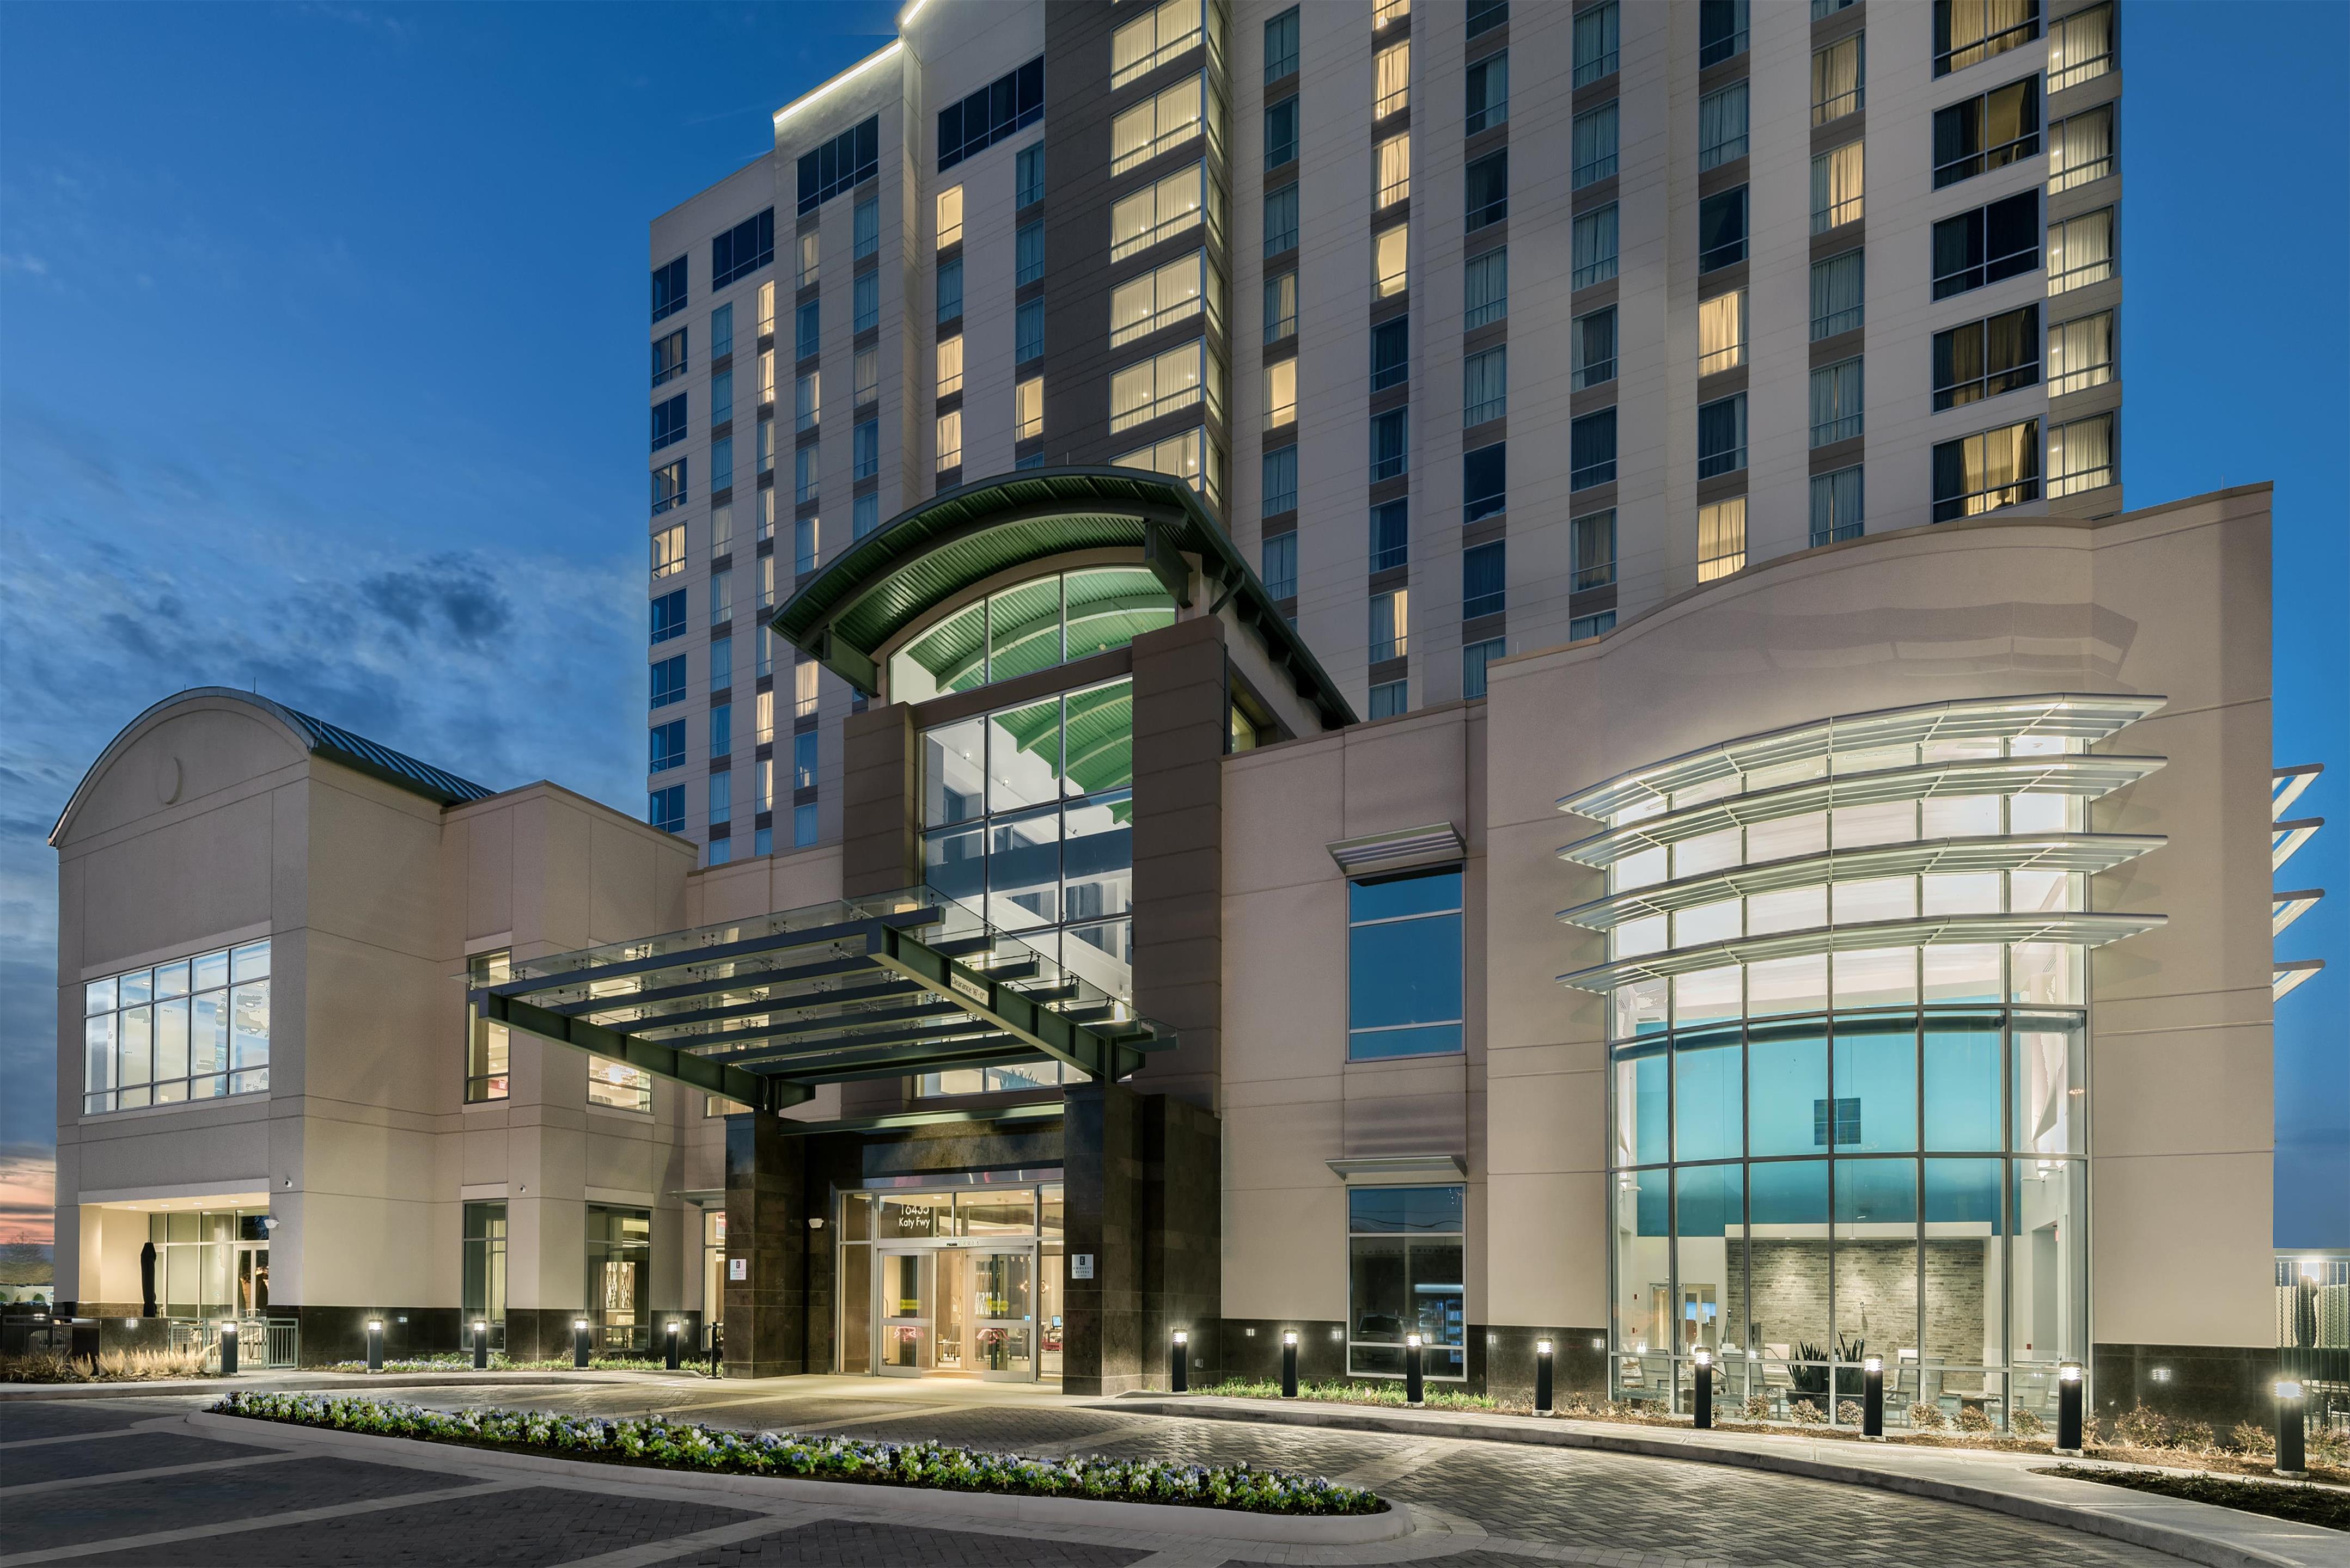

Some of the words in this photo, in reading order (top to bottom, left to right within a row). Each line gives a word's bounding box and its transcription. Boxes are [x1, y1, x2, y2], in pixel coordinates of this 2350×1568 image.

[951, 976, 972, 994] Clearance
[899, 1217, 915, 1229] Katy
[916, 1217, 930, 1229] Fwy
